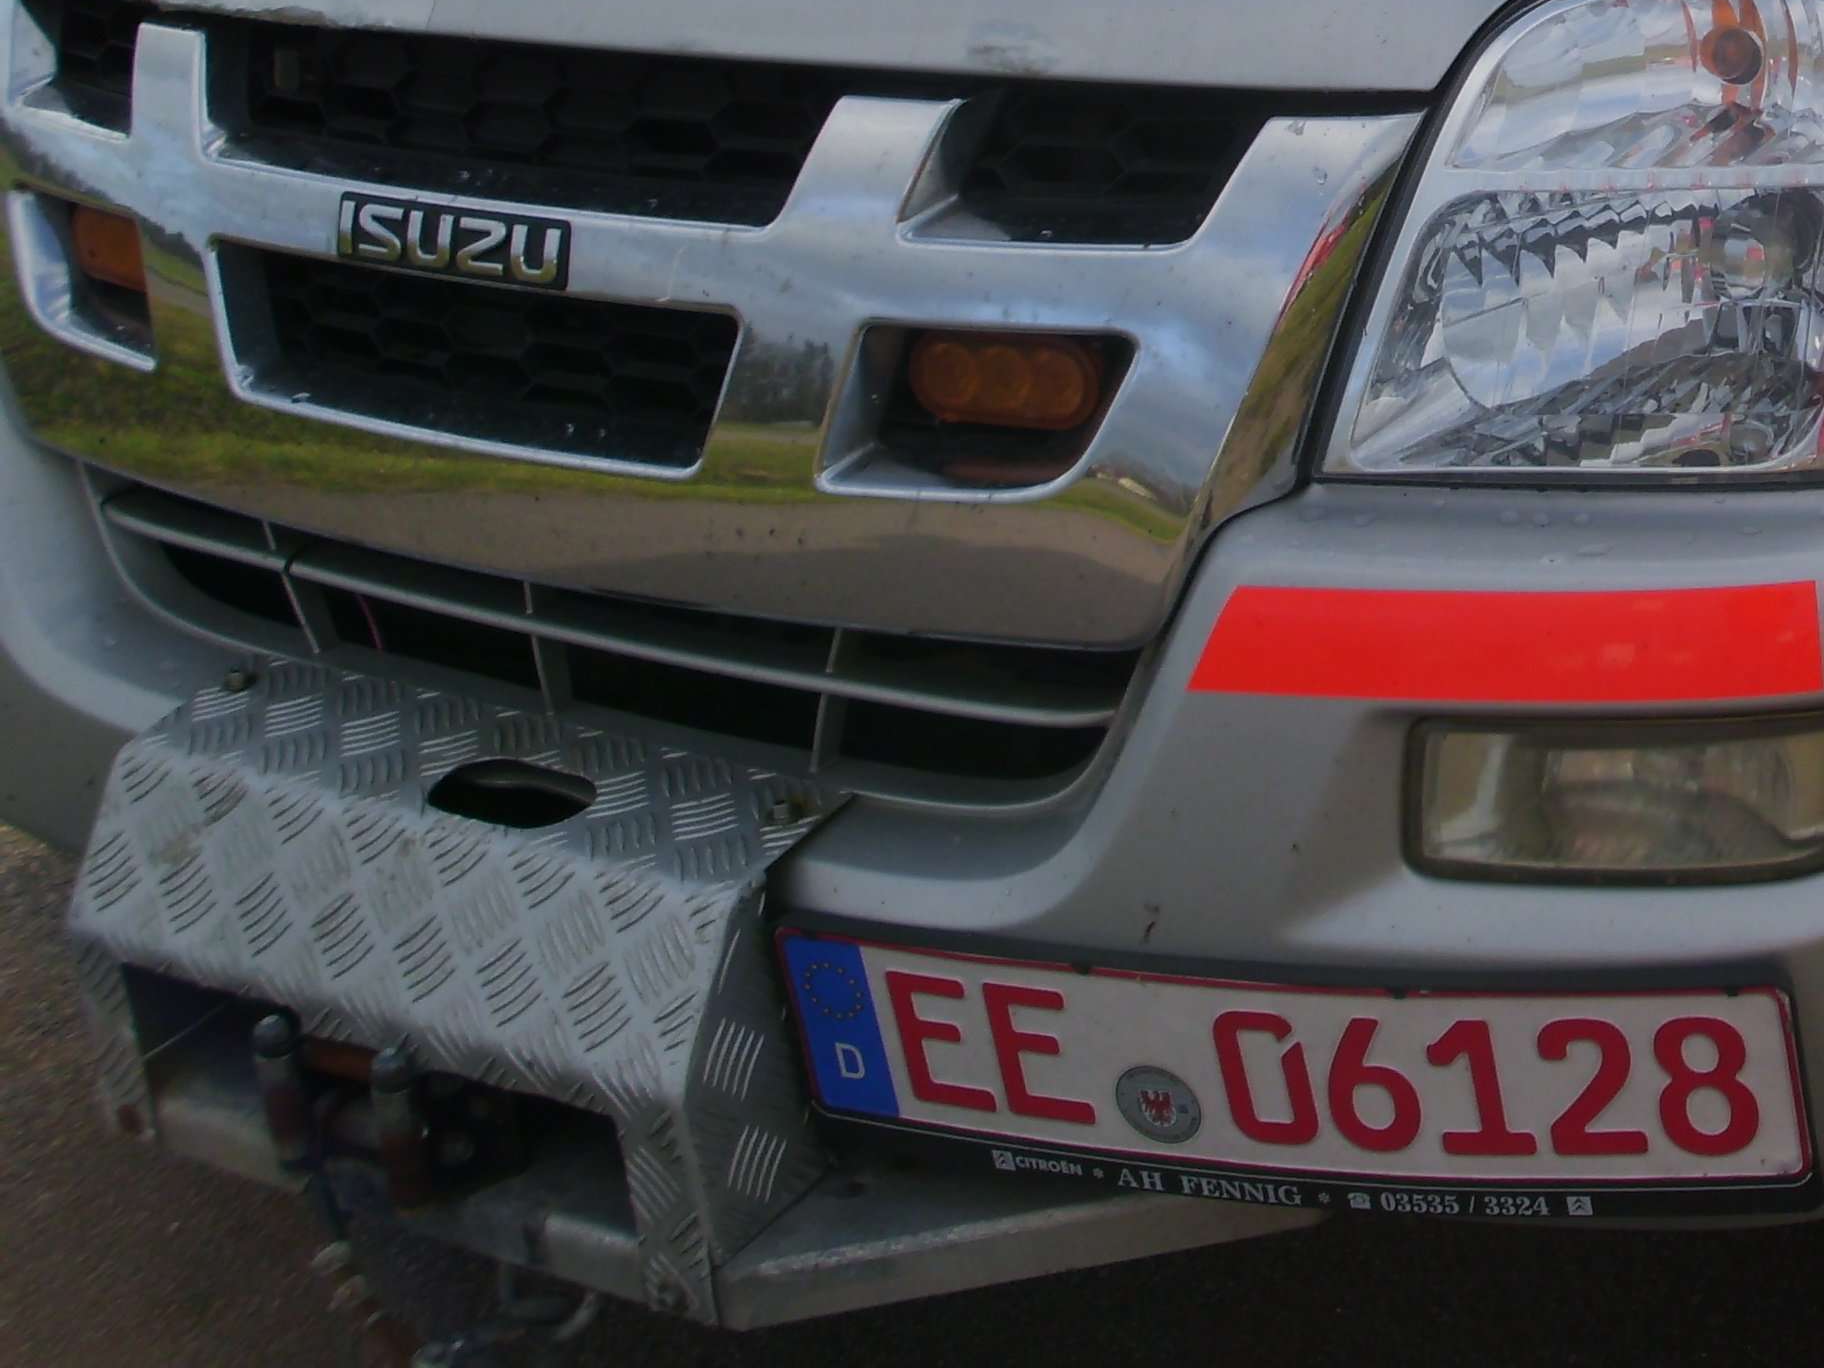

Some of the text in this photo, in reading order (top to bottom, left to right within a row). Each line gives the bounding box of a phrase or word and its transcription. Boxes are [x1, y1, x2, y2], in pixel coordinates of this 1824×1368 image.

[340, 200, 560, 282] ISUZU
[834, 1042, 866, 1080] D
[886, 970, 1096, 1126] EE
[1211, 1009, 1760, 1157] 06128
[1014, 1154, 1083, 1177] CITROËN
[1117, 1167, 1165, 1192] AH
[1180, 1174, 1302, 1206] FENNIG
[1380, 1191, 1460, 1215] 03535
[1484, 1195, 1551, 1216] 3324
